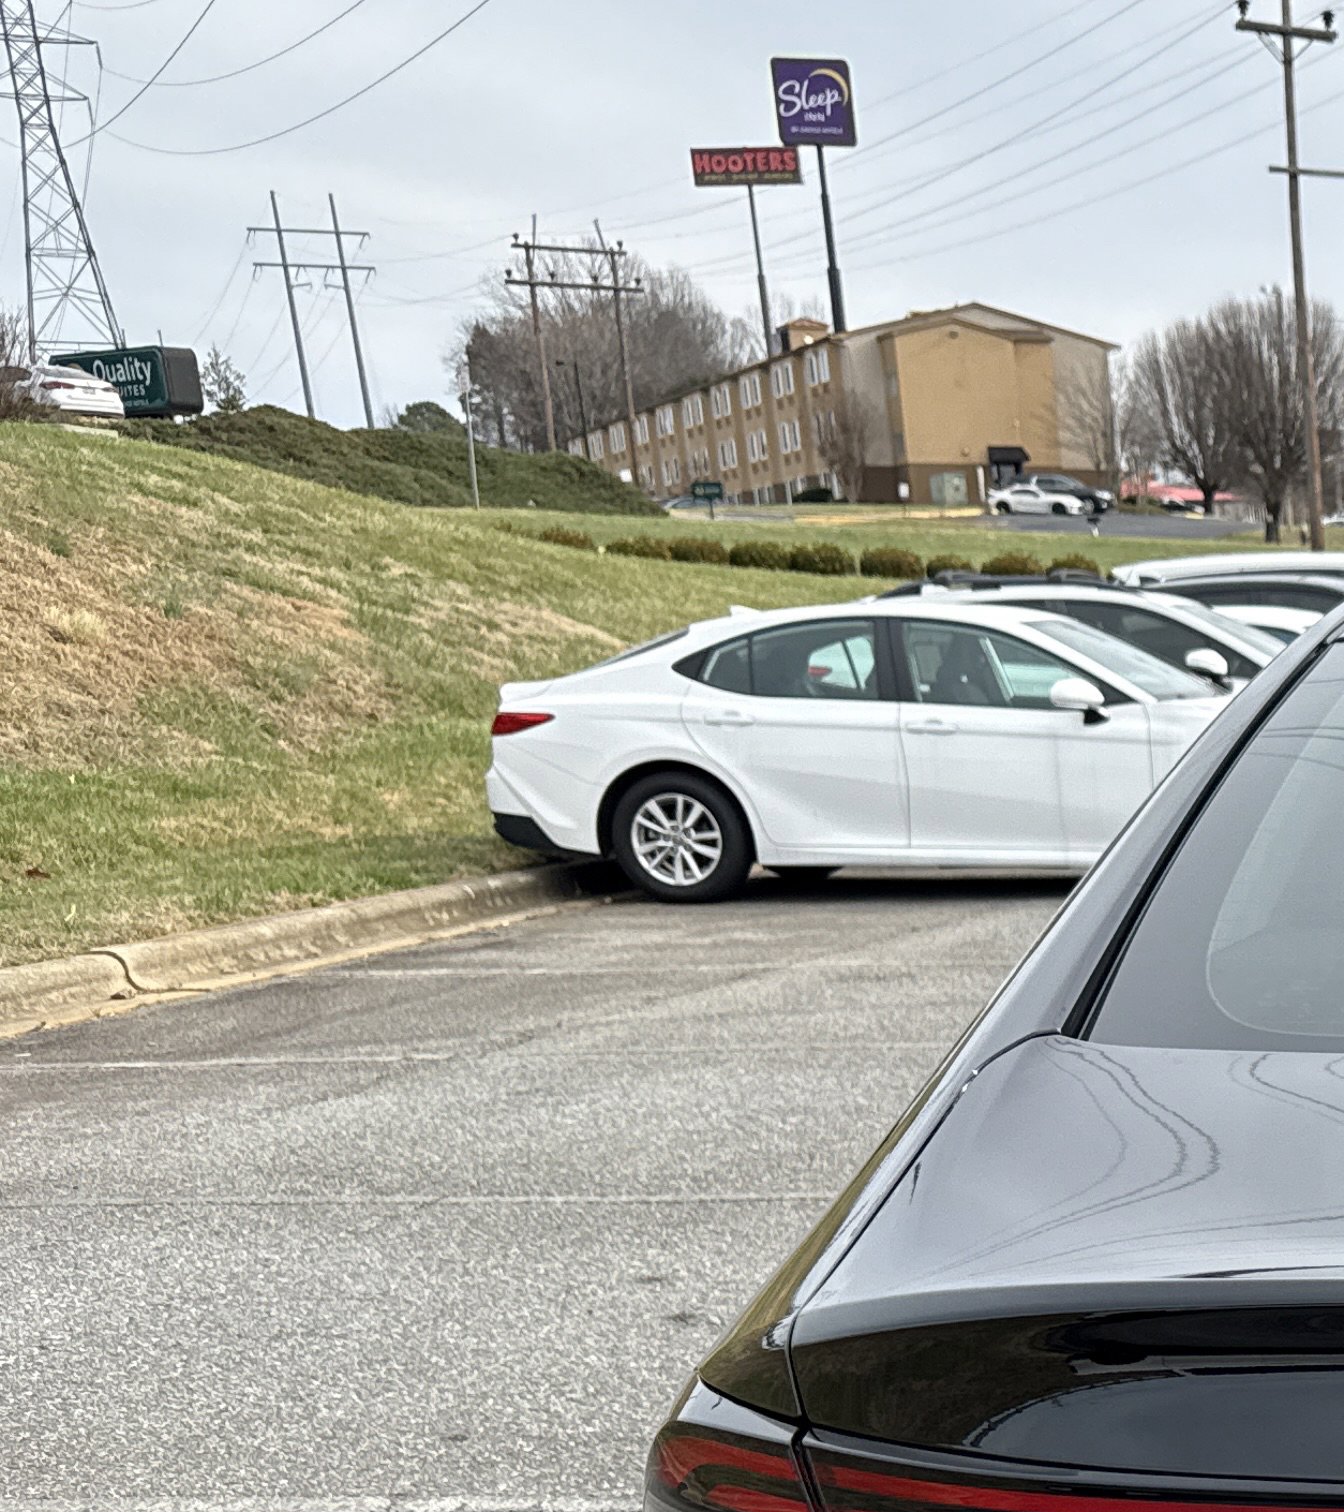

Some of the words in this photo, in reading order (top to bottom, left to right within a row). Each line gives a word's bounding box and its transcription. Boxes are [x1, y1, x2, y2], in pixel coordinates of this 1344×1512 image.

[778, 78, 842, 117] Sleep
[694, 151, 796, 174] HOOTERS
[93, 356, 151, 386] Quality
[118, 384, 146, 397] UITES
